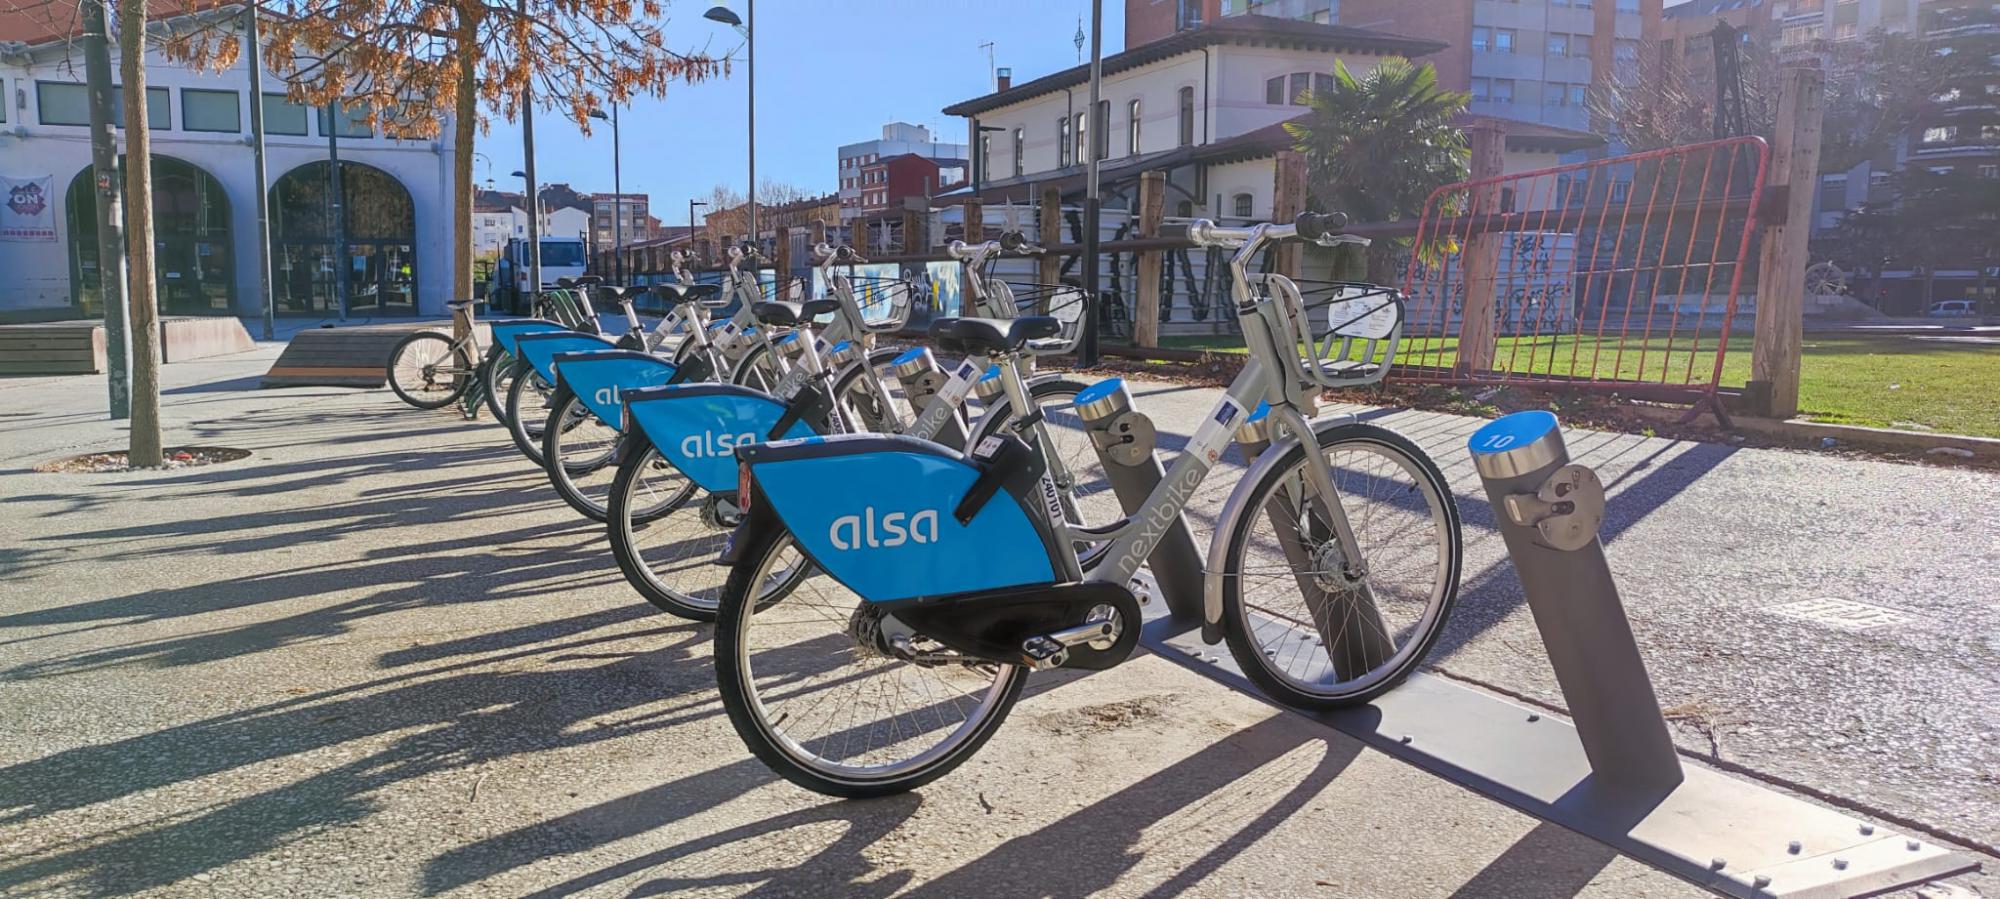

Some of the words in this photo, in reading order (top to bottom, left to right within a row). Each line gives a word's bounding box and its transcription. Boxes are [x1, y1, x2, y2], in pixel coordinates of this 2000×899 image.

[14, 194, 38, 204] ON
[595, 384, 621, 405] al
[912, 407, 948, 440] bike
[681, 430, 756, 458] alsa
[1483, 435, 1515, 448] 10
[1042, 476, 1062, 518] 240101
[830, 506, 938, 550] alsa
[1118, 468, 1201, 574] nextbike
